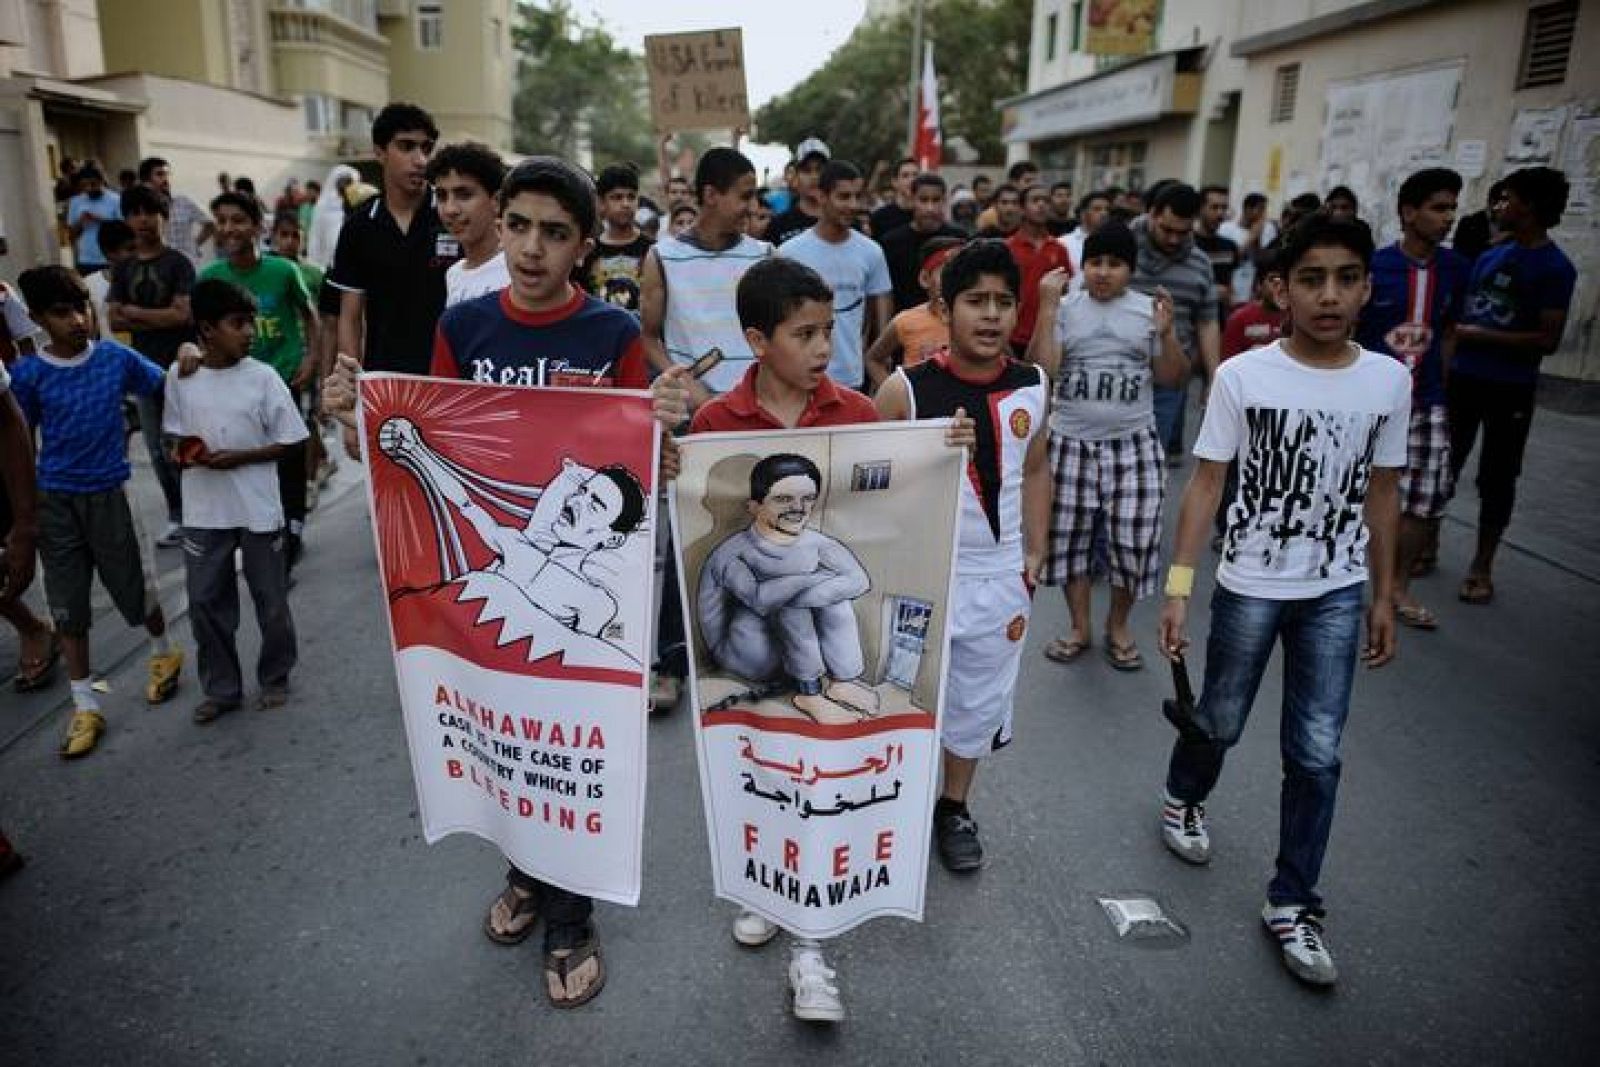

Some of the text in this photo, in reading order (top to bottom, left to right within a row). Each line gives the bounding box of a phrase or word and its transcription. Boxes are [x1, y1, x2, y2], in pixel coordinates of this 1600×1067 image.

[472, 357, 549, 387] Real
[435, 684, 605, 749] ALKHAWAJA
[438, 712, 472, 736] CASE
[492, 739, 522, 761] THE
[530, 749, 571, 771] CASE
[580, 759, 604, 775] OF
[442, 734, 454, 748] A
[524, 770, 577, 797] WHICH
[586, 783, 603, 799] IS
[446, 759, 602, 834] BLEEDING
[743, 823, 894, 878] FREE
[744, 857, 890, 908] ALKHAWAJA
